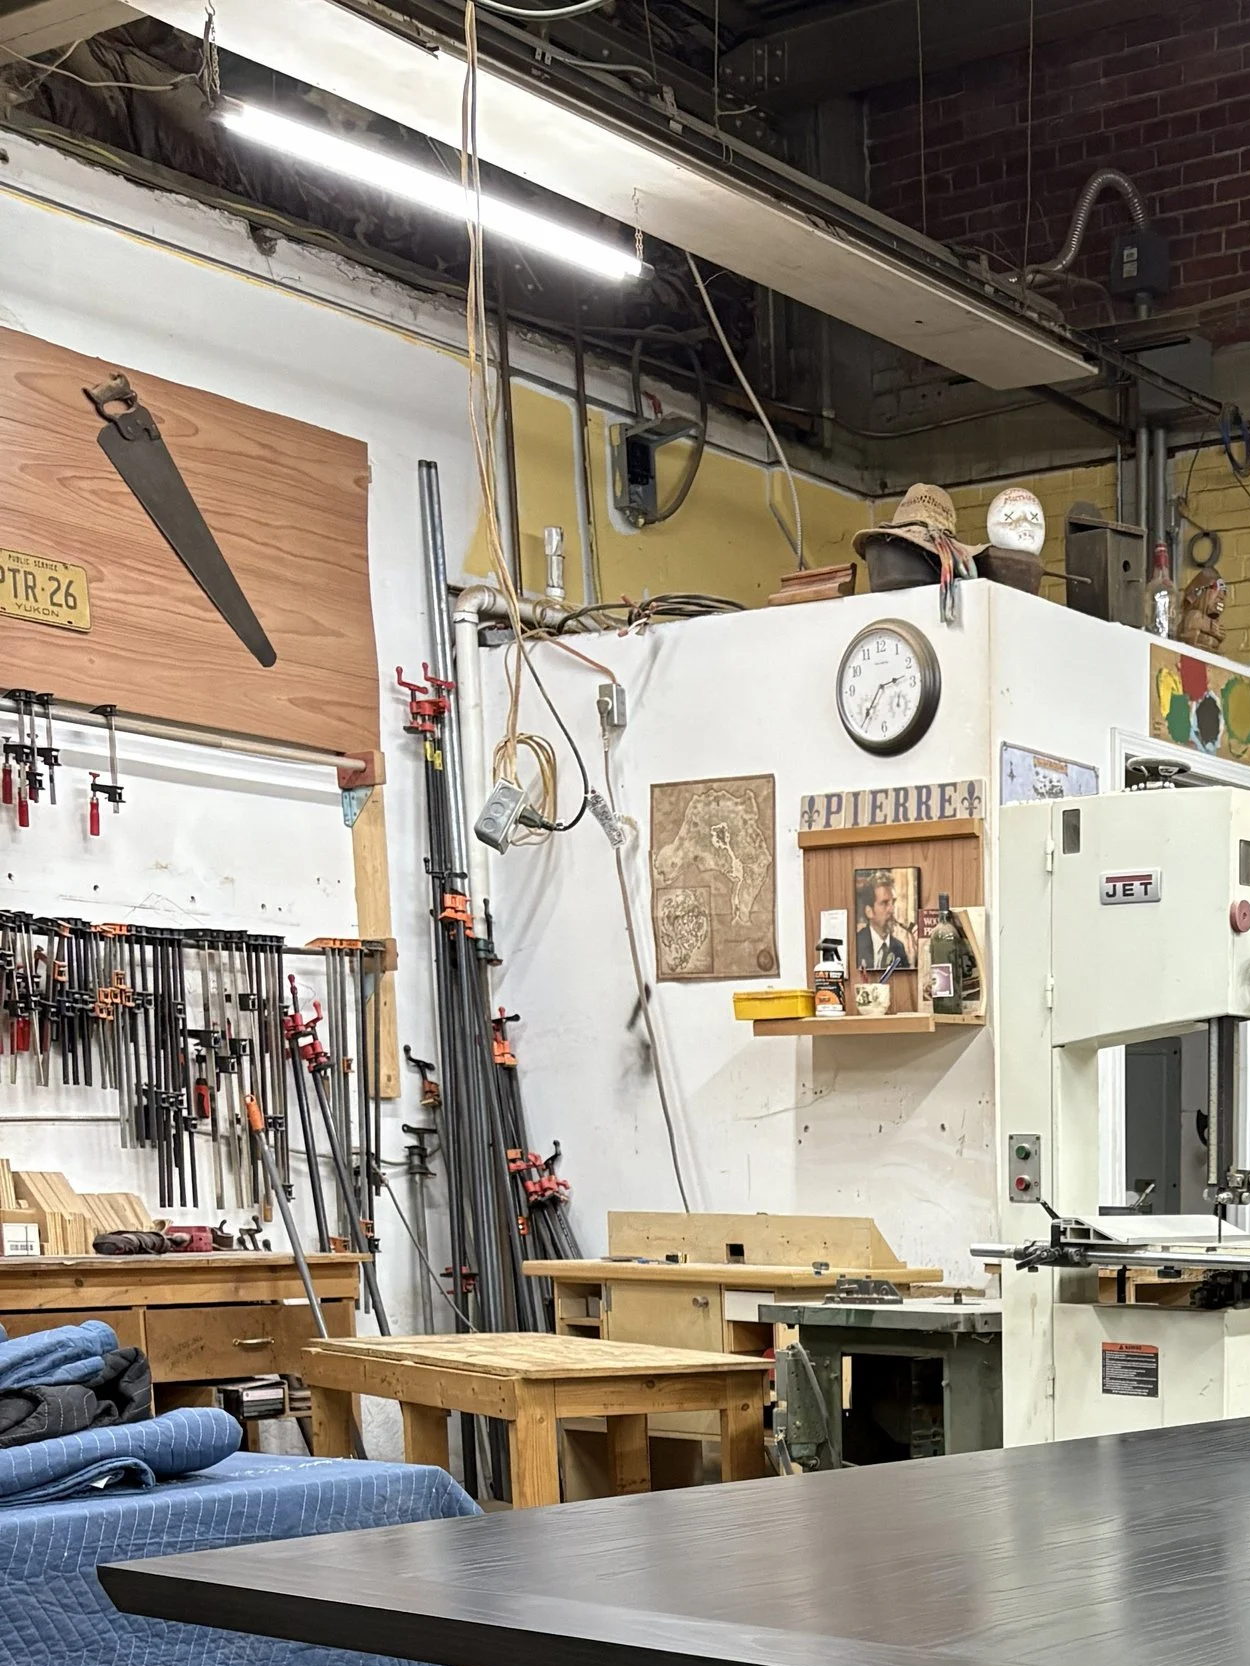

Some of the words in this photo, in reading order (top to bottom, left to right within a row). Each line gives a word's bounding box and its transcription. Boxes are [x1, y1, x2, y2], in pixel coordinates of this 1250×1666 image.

[15, 602, 59, 617] YUKON
[876, 640, 886, 653] 12
[862, 648, 871, 661] 11
[905, 656, 912, 669] 2
[852, 665, 862, 678] 10
[909, 675, 916, 688] 3
[849, 684, 855, 697] 9
[881, 721, 888, 733] 6
[824, 782, 957, 828] PIERRE
[1106, 882, 1152, 898] JET
